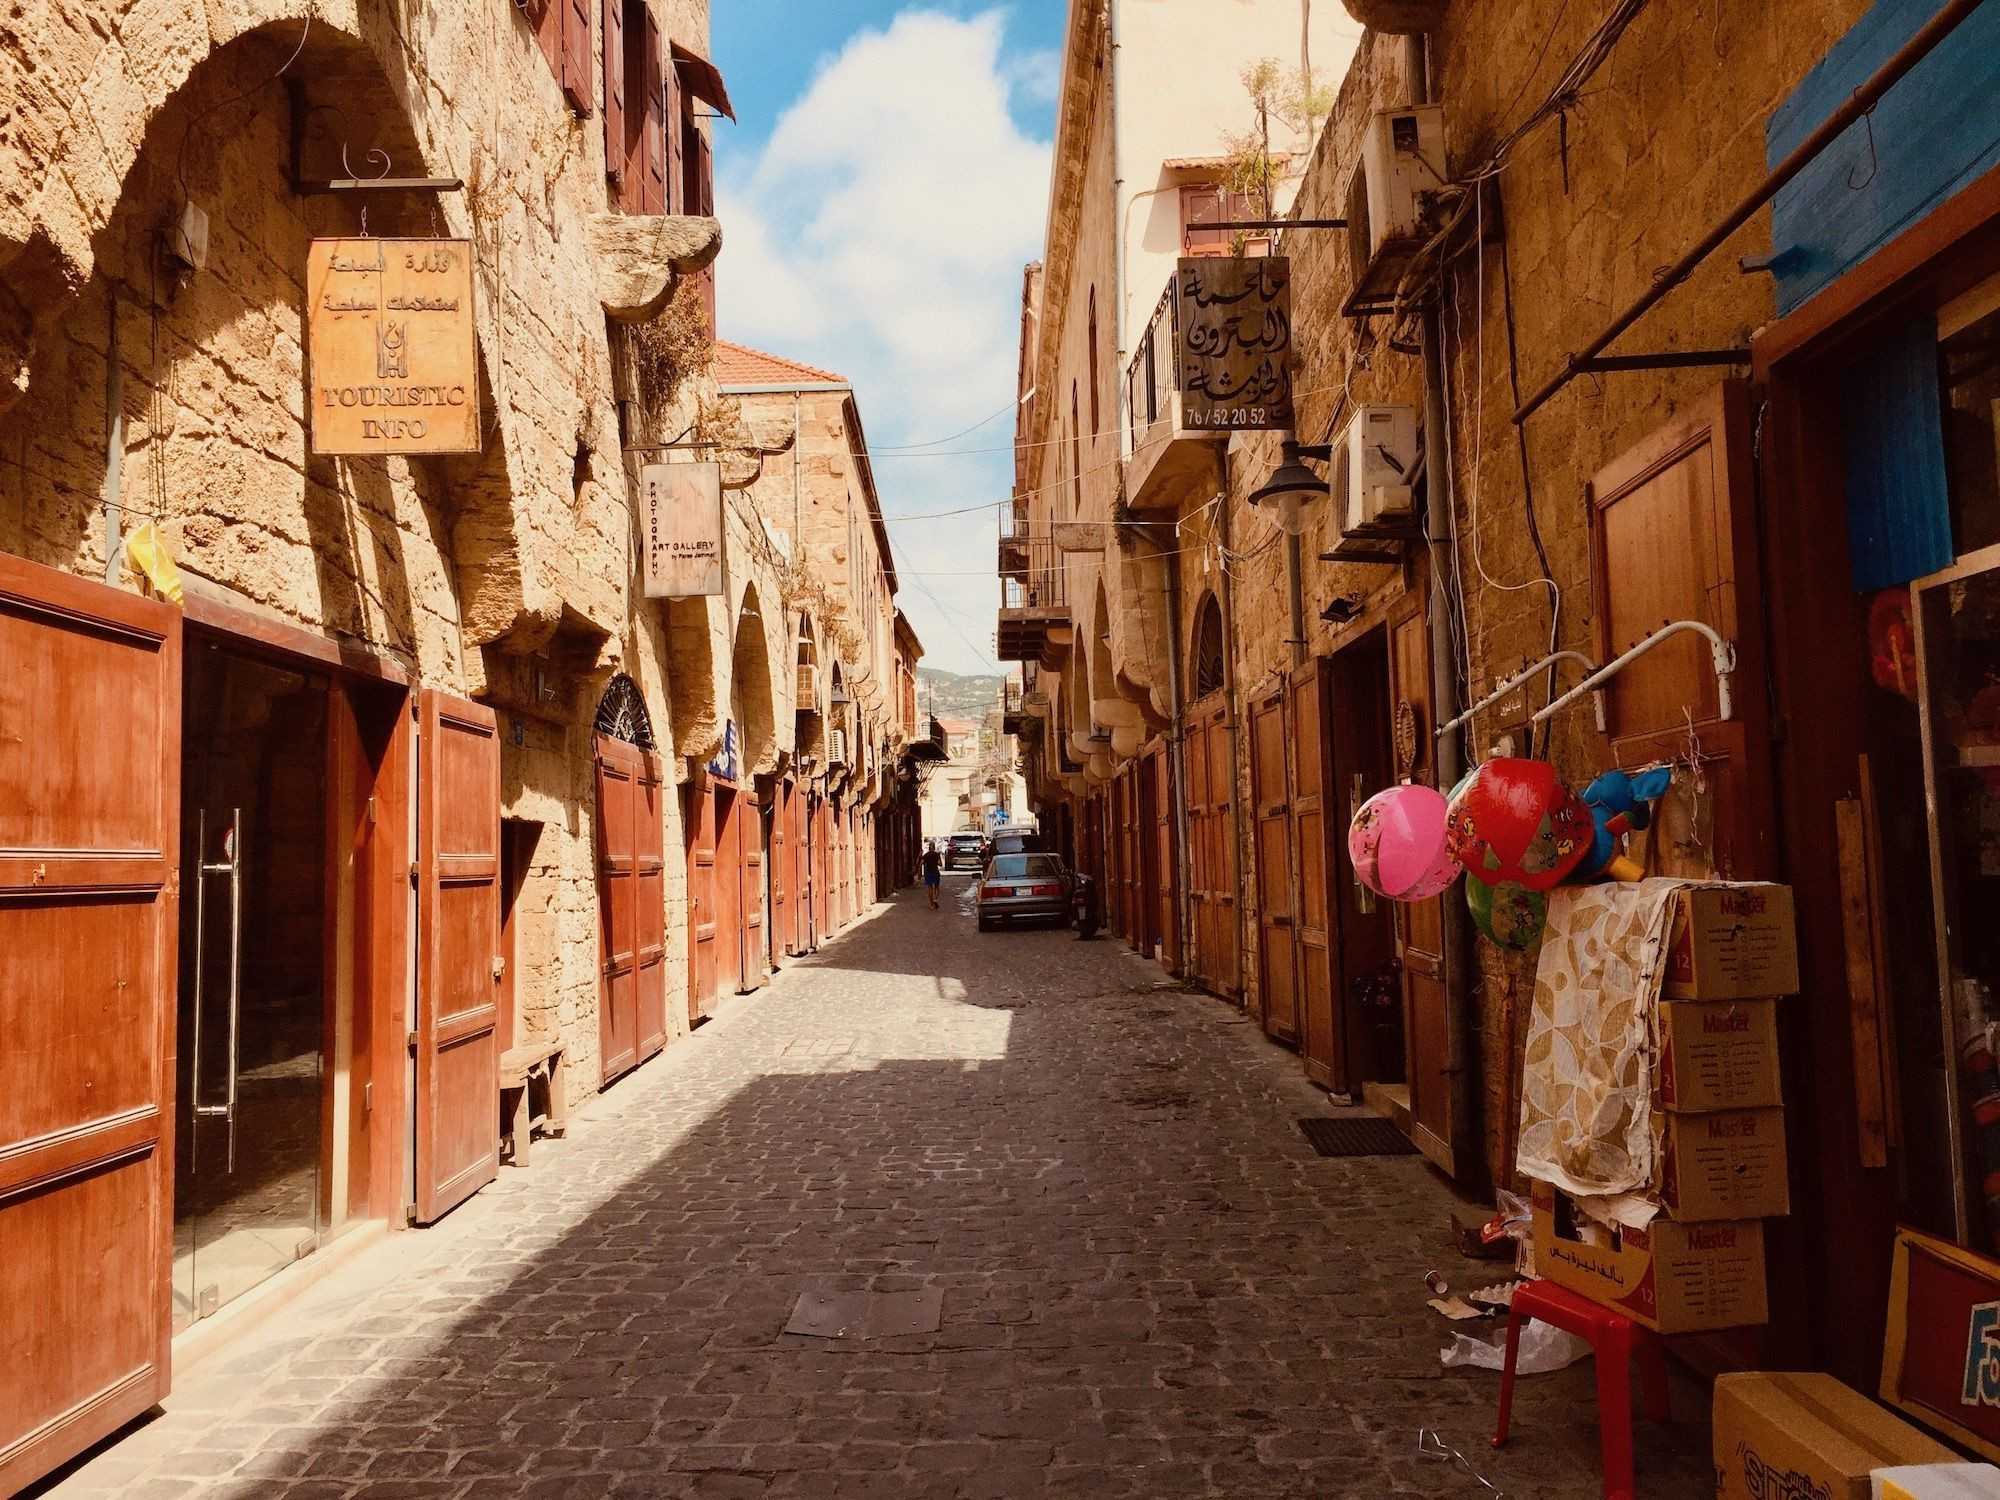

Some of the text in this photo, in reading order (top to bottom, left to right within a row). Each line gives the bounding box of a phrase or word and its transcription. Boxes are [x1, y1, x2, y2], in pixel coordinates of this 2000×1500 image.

[405, 252, 452, 273] وزارة
[1183, 260, 1286, 308] ملحمة
[1186, 304, 1289, 358] البترون
[1186, 358, 1289, 405] الحديثة
[320, 385, 466, 407] TOURISTIC
[1213, 409, 1228, 425] 52
[1231, 408, 1247, 424] 20
[1250, 407, 1266, 425] 52
[361, 420, 428, 439] INFO
[650, 482, 658, 578] PHOTOGRAPHY
[673, 541, 715, 551] GALLERY
[1688, 1230, 1736, 1250] Master
